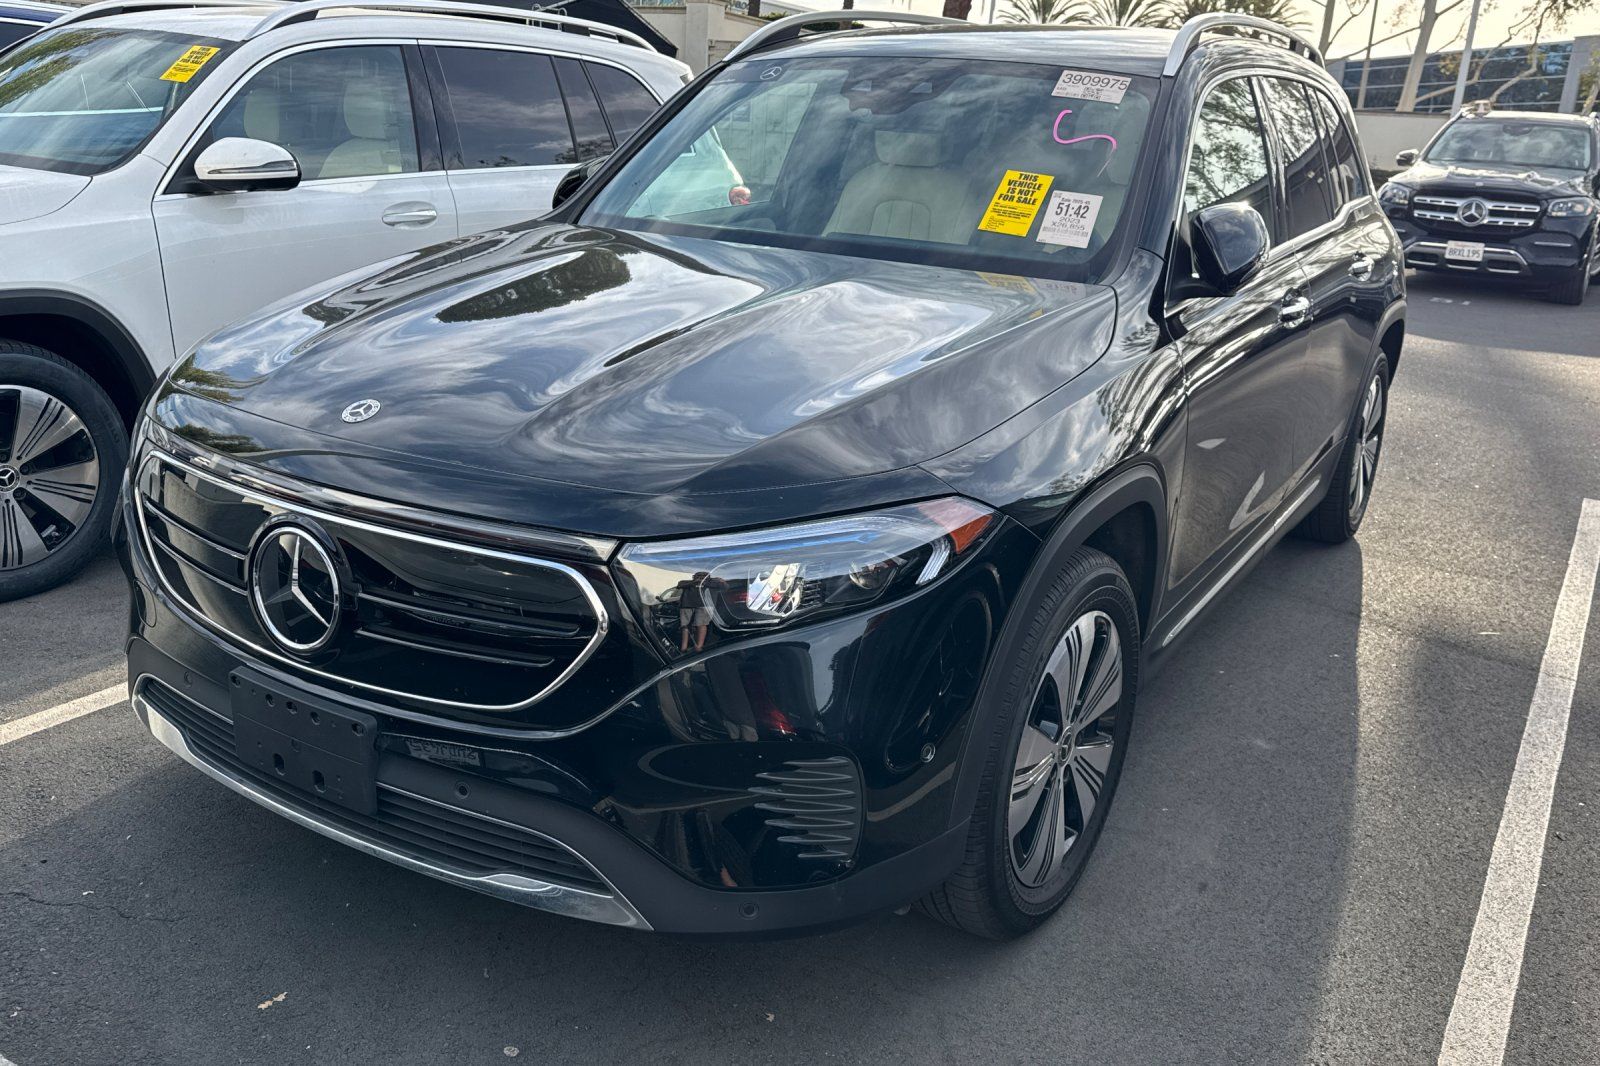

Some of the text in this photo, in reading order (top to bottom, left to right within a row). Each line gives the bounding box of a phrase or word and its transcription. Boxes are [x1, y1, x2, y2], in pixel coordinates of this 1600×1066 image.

[1062, 73, 1129, 91] 3909975
[1018, 173, 1039, 182] THIS
[1007, 179, 1043, 191] VEHICLE
[1017, 188, 1036, 197] NOT
[998, 193, 1015, 202] FOR
[1016, 196, 1038, 206] SALE
[1055, 202, 1090, 219] 51:42
[1059, 216, 1080, 225] 2023
